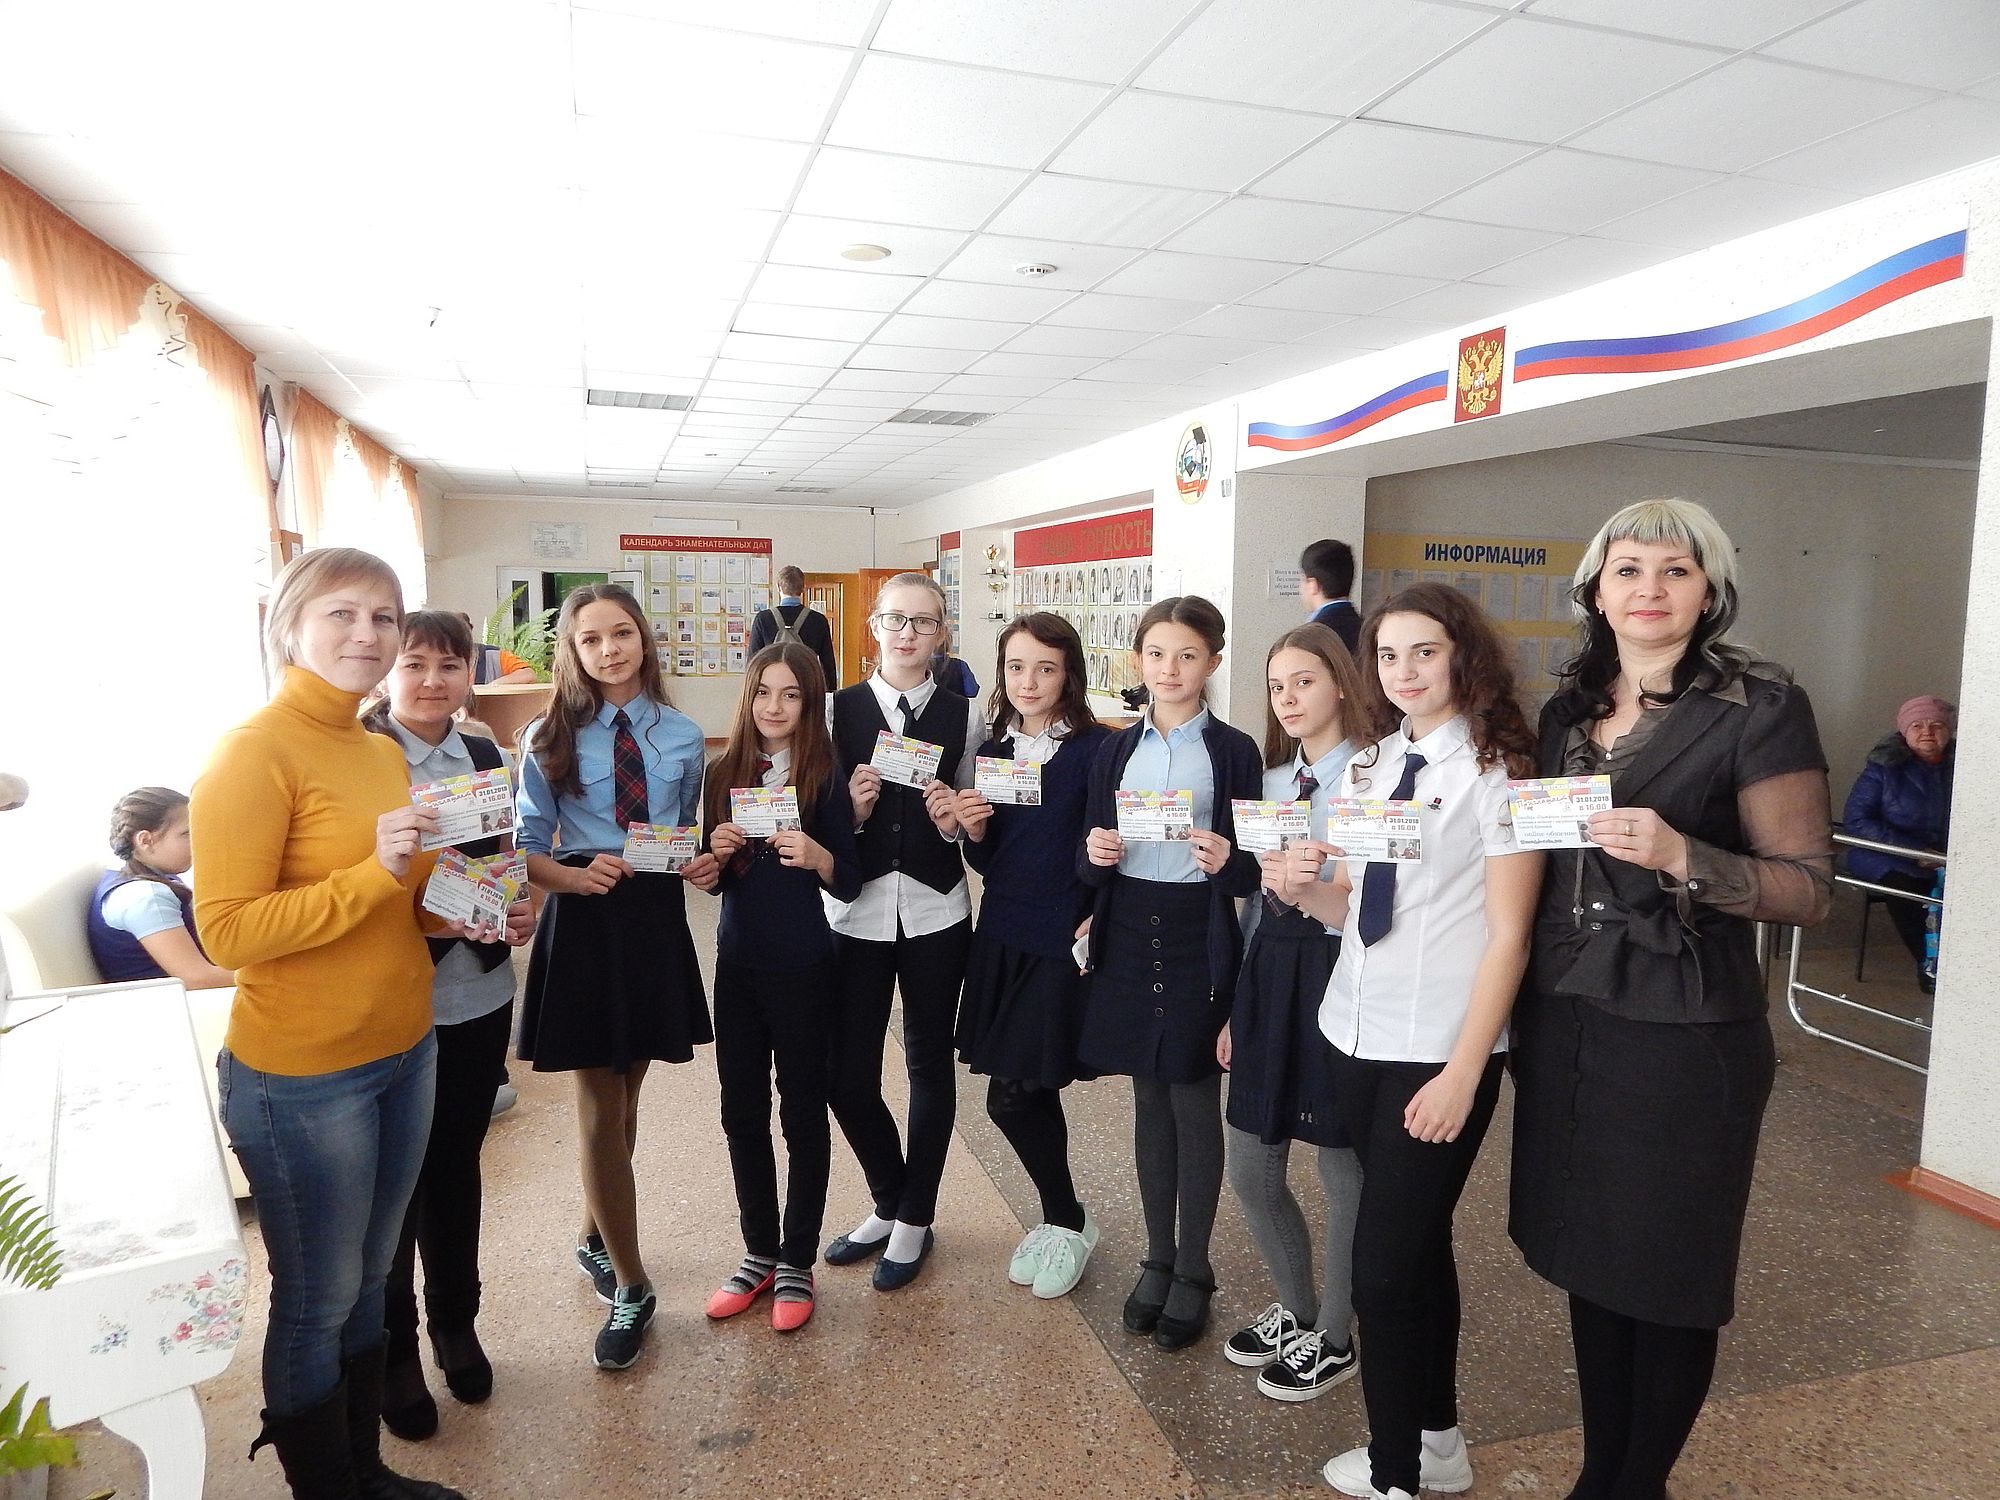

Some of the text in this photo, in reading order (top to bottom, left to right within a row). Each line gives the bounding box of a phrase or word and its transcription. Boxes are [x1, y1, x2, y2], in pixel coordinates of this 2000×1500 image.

[624, 538, 673, 548] КАЛЕНДАРЬ
[675, 539, 751, 549] ЗНАМЕНАТЕЛЬНЫХ
[1424, 543, 1547, 567] ИНФОРМАЦИЯ
[479, 786, 508, 797] 31.01.2018
